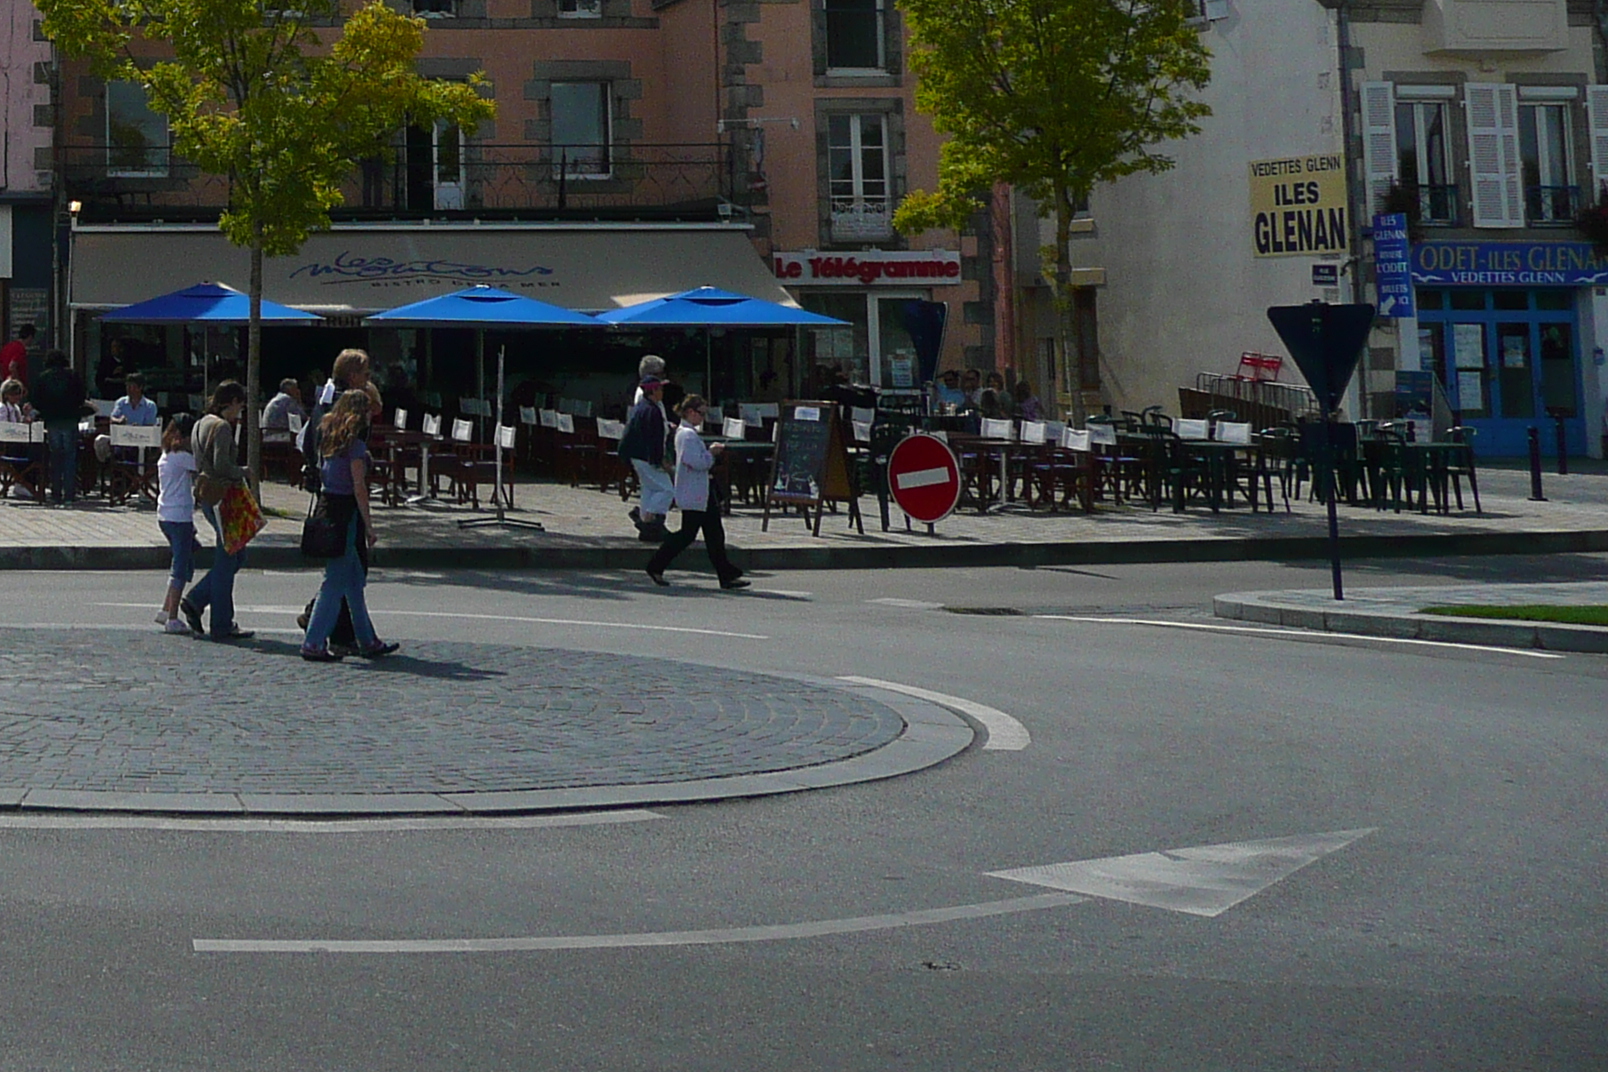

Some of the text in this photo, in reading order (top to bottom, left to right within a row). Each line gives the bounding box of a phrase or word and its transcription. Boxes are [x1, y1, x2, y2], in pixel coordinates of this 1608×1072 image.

[1252, 156, 1341, 177] VEDETTES GLENN
[1274, 181, 1320, 206] ILES
[1255, 207, 1346, 254] GLENAN
[775, 257, 959, 283] Le Télégramme
[1451, 271, 1565, 283] VEDETTES GLENN
[371, 279, 441, 288] BISTRO
